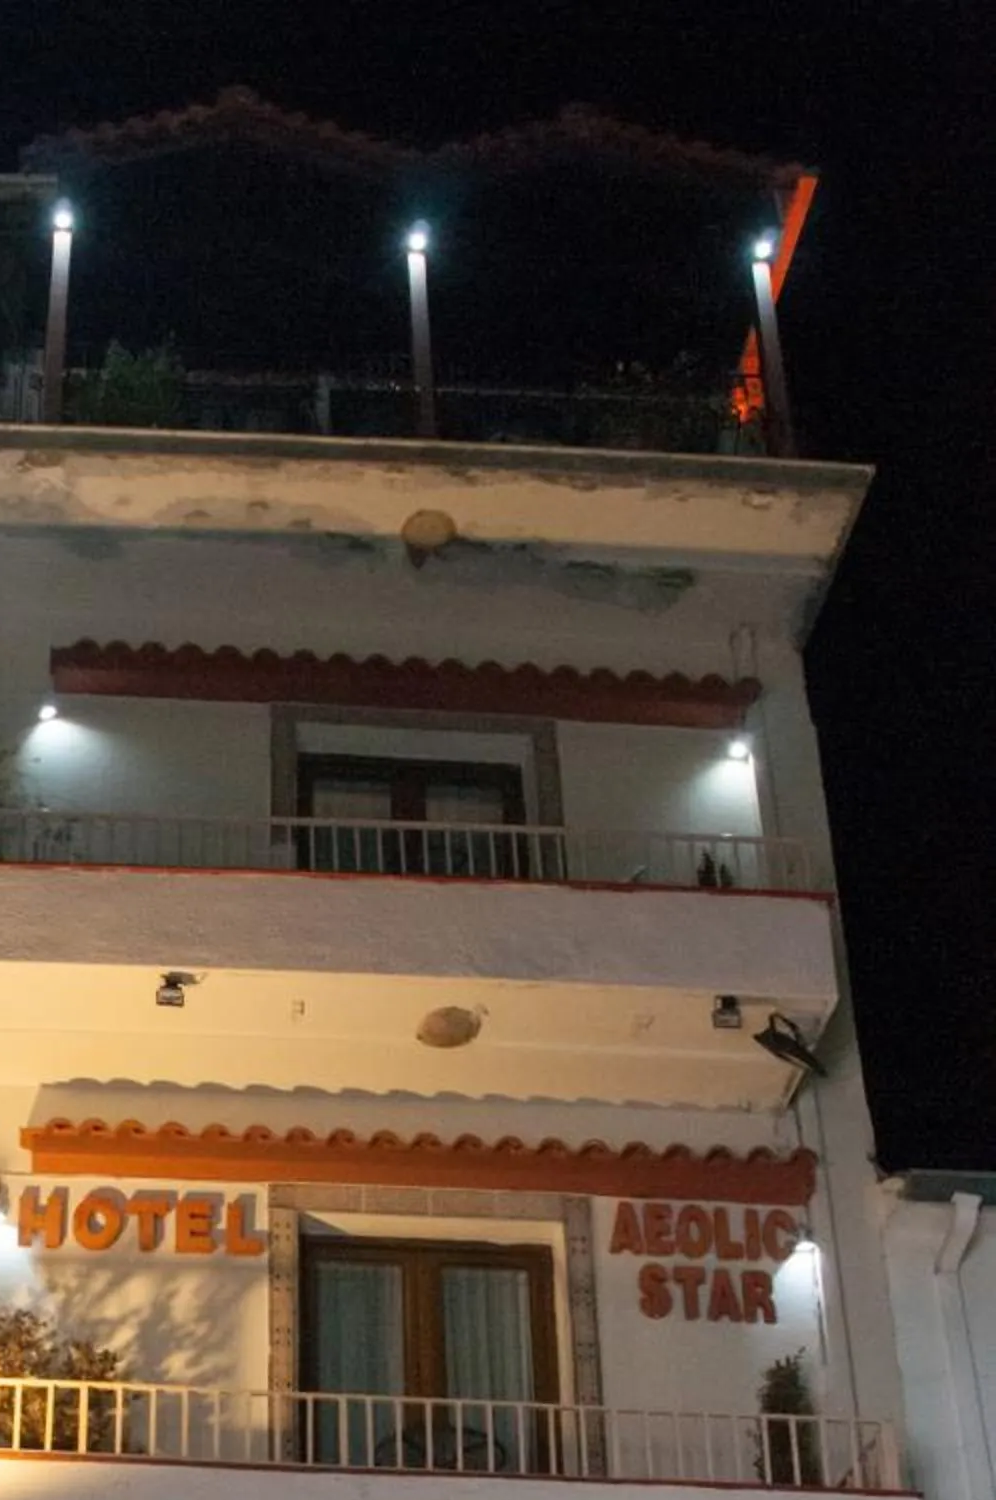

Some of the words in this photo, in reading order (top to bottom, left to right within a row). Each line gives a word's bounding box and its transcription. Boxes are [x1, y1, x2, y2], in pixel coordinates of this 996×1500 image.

[17, 1187, 268, 1257] HOTEL
[609, 1201, 799, 1261] AEOLIC
[638, 1262, 777, 1325] STAR
